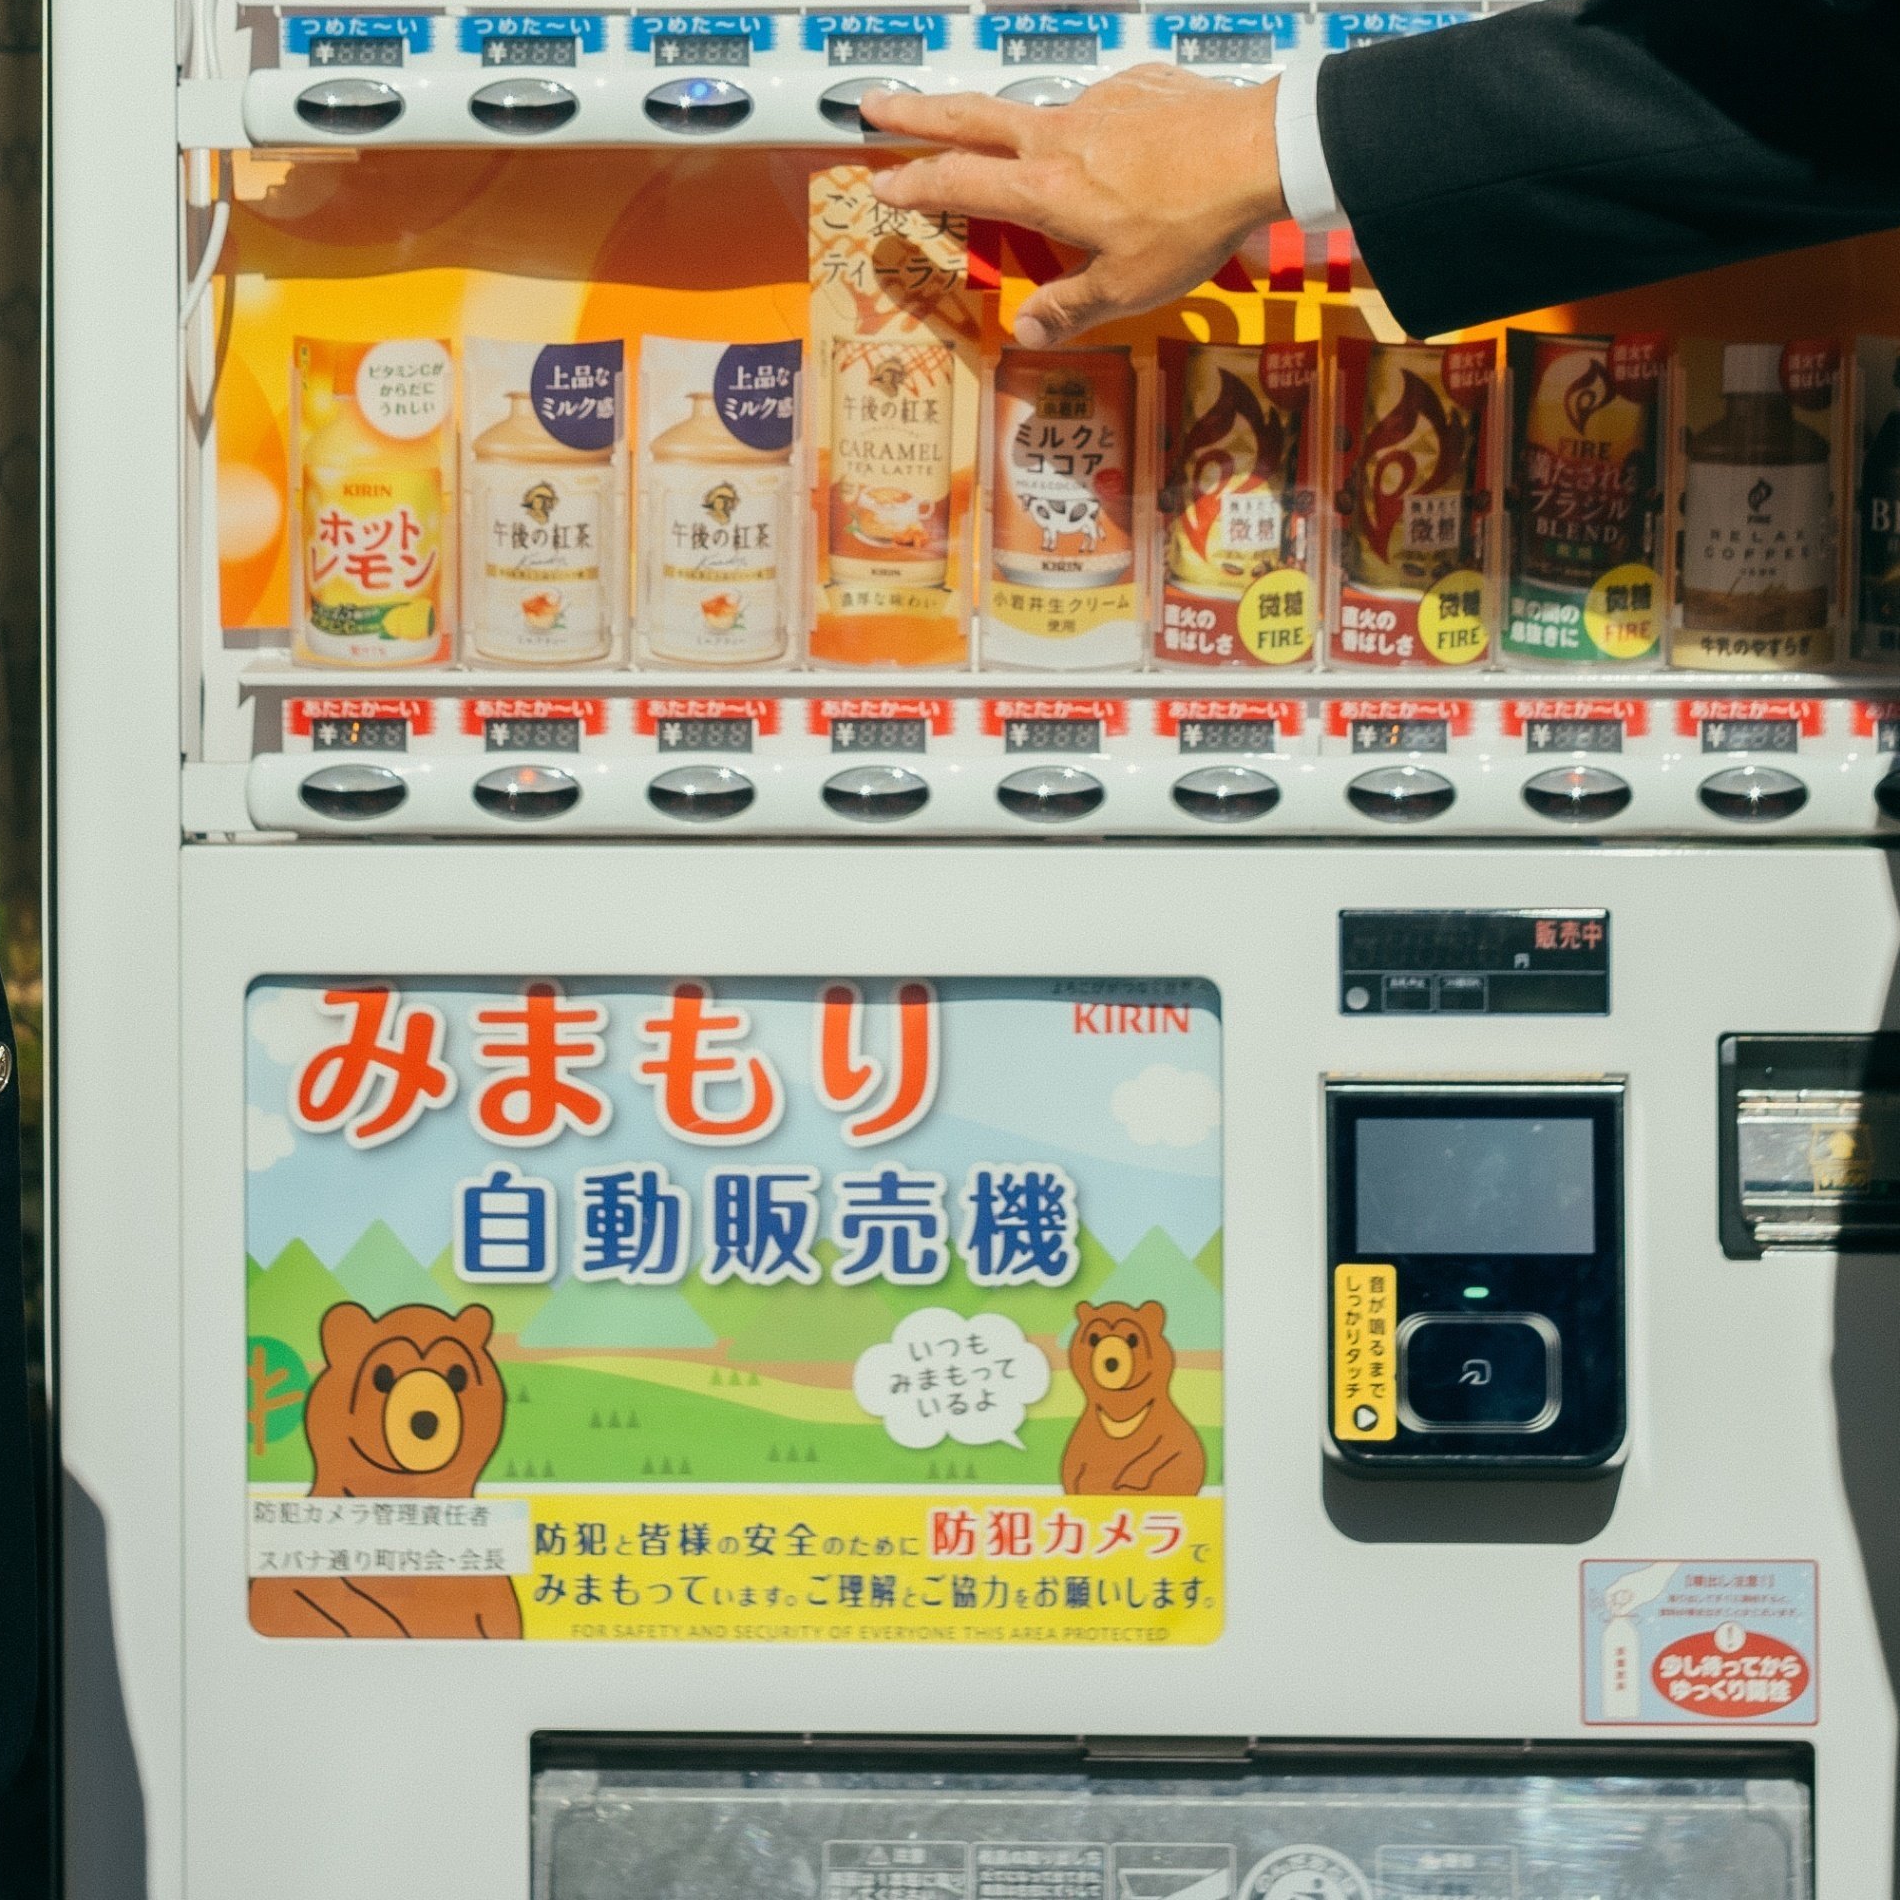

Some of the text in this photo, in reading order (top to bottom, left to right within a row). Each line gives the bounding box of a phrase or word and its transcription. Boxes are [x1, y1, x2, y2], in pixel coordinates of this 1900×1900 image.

[822, 253, 968, 290] ティーラテ
[380, 381, 436, 397] からだに
[545, 365, 610, 390] 上品な
[728, 365, 790, 390] 上品な
[380, 401, 436, 415] うれしい
[541, 396, 614, 420] ミルク感
[722, 396, 793, 419] ミルク感
[843, 396, 940, 424] 午後の紅茶
[1015, 424, 1115, 450] ミルクと
[838, 440, 941, 462] CARAMEL
[1027, 452, 1104, 476] ココア
[343, 483, 392, 497] KIRIN
[319, 509, 420, 551] ホット
[493, 522, 594, 550] 午後の紅茶
[672, 519, 770, 548] 午後の紅茶
[310, 545, 438, 590] レモン
[1041, 561, 1083, 573] KIRIN
[1258, 628, 1304, 650] FIRE
[1437, 627, 1481, 650] FIRE
[1604, 621, 1651, 643] FIRE
[1534, 920, 1603, 950] 販売中
[1074, 1002, 1191, 1034] KIRIN
[297, 981, 933, 1138] みまもり
[464, 1168, 1070, 1278] 自動販売機
[907, 1331, 990, 1363] いつも
[1345, 1275, 1361, 1399] しっかりタッチ
[888, 1355, 1017, 1395] みまもって
[915, 1387, 998, 1419] いるよ
[253, 1502, 490, 1527] 防犯カメラ管理責任者
[570, 1624, 607, 1638] FOR
[612, 1624, 682, 1638] SAFETY
[688, 1624, 726, 1638] AND
[1659, 1654, 1802, 1679] 少し待ってから
